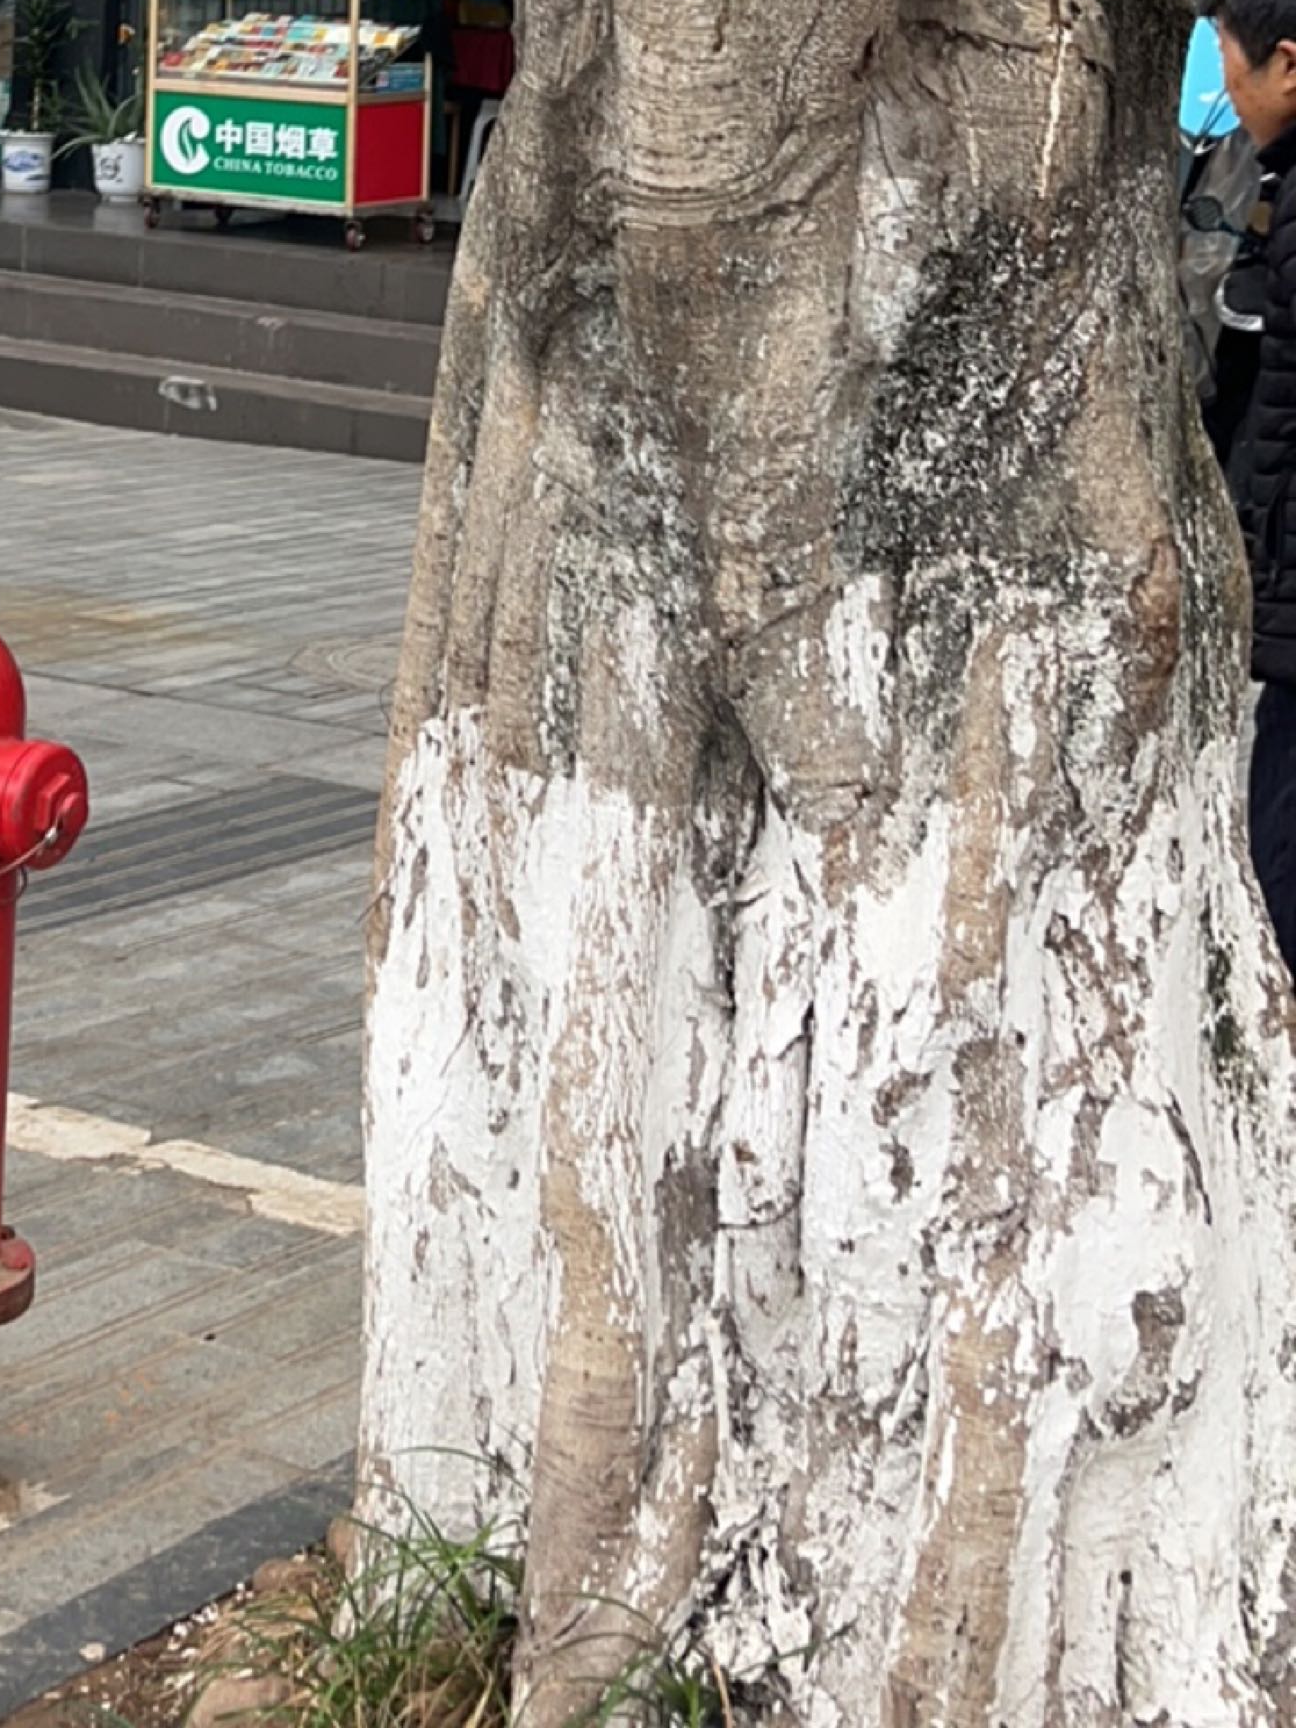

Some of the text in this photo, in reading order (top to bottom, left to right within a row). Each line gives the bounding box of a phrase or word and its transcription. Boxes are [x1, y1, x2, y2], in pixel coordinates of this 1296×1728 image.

[215, 118, 339, 162] 中国烟草
[214, 156, 340, 182] CHINA TOBACCO
